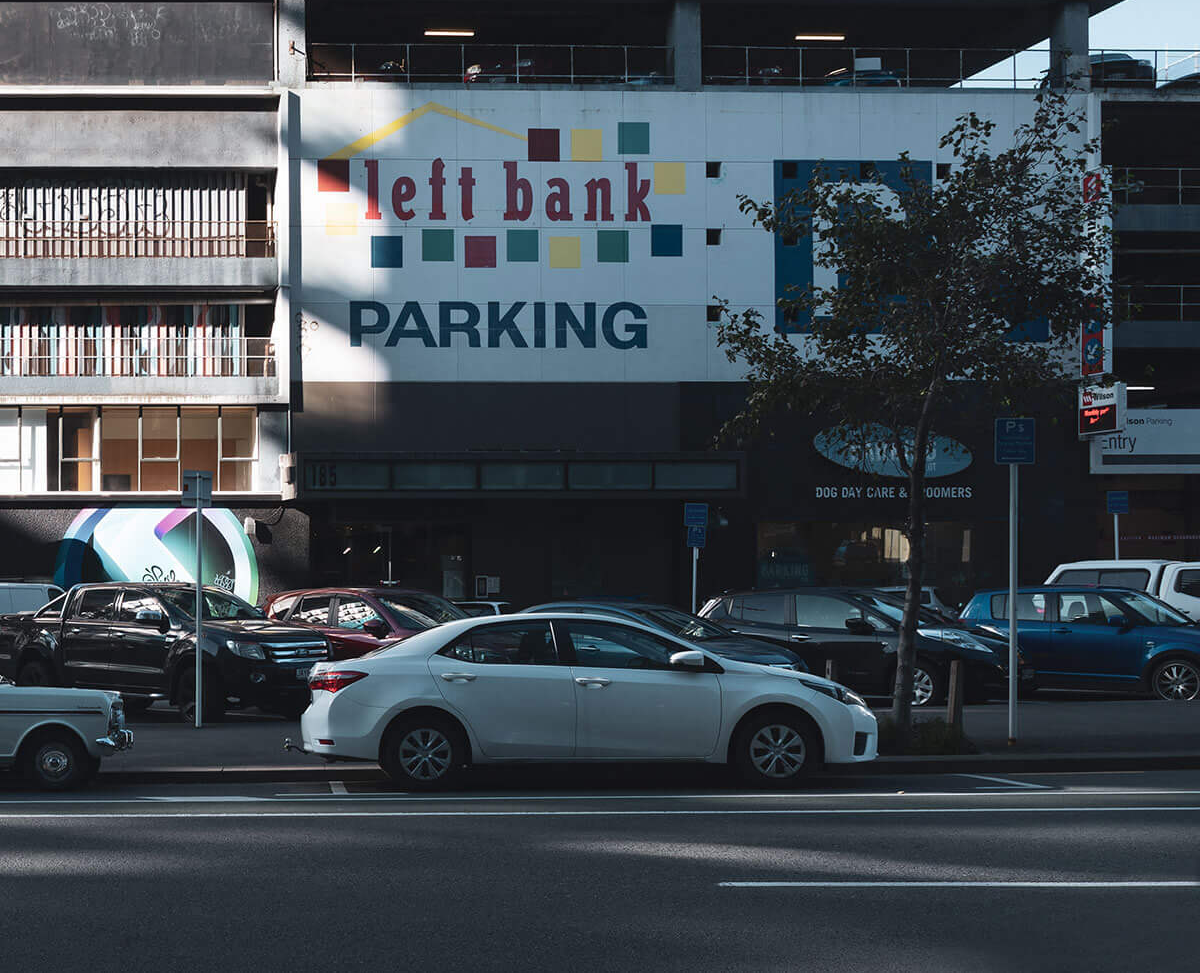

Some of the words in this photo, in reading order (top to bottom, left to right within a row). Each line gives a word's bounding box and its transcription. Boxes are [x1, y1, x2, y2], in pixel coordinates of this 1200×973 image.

[364, 157, 476, 221] left
[503, 160, 651, 222] bank
[349, 300, 649, 350] PARKING
[1146, 417, 1174, 427] Parking
[311, 466, 337, 486] 185
[815, 487, 838, 498] DOG
[841, 487, 863, 498] DAY
[866, 487, 895, 498] CARE
[898, 487, 908, 498] &
[923, 487, 973, 498] OOMERS
